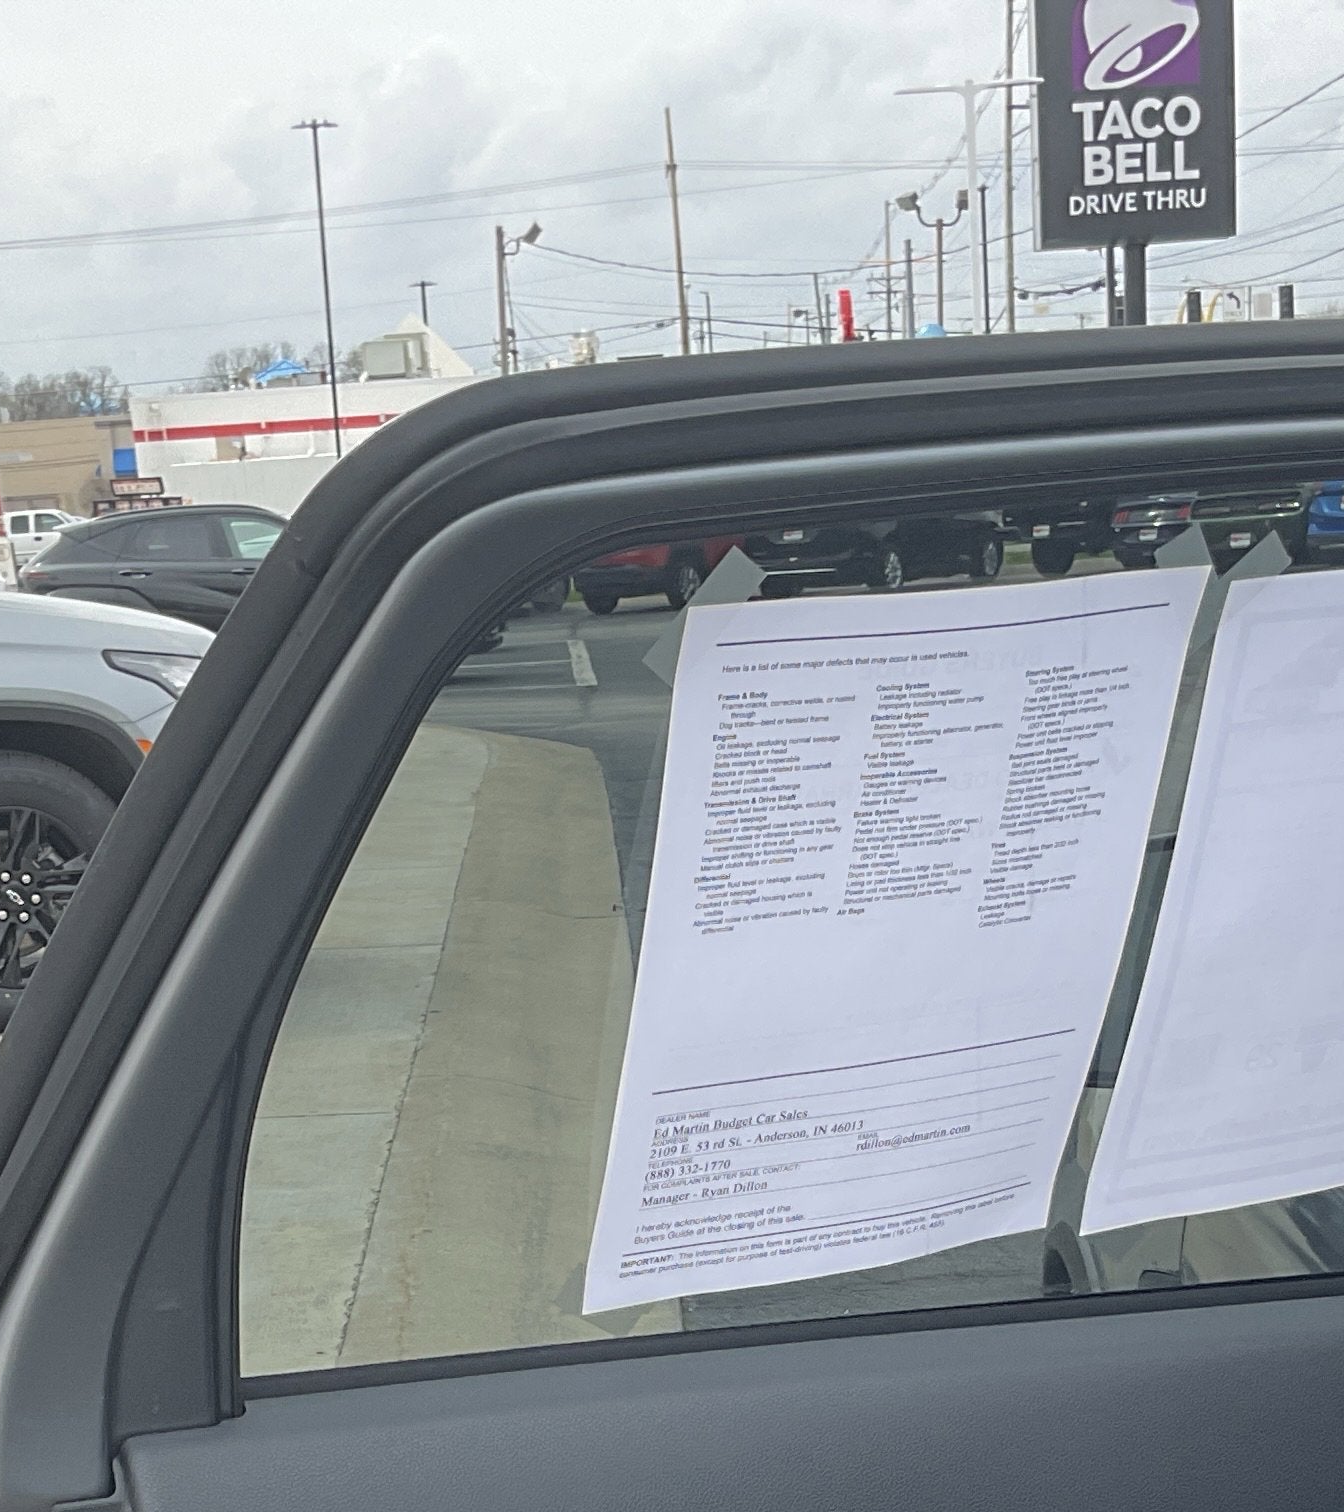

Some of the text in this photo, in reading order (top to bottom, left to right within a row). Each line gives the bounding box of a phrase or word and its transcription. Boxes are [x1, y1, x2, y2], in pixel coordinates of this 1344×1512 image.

[1072, 96, 1200, 141] TACO
[1083, 141, 1199, 186] BELL
[1069, 187, 1207, 216] DRIVE THRU
[721, 664, 741, 673] Here
[757, 662, 769, 670] list
[802, 658, 824, 669] major
[825, 656, 853, 666] defects
[854, 655, 870, 664] that
[870, 656, 887, 664] may
[910, 652, 918, 660] in
[918, 650, 937, 659] used
[938, 649, 969, 658] vehicles.
[652, 1109, 808, 1139] Ed Martin Budget Car Sales
[649, 1146, 676, 1159] 2109
[695, 1141, 709, 1153] 53
[712, 1139, 724, 1150] rd
[753, 1131, 809, 1145] Anderson,
[812, 1125, 827, 1136] IN
[830, 1120, 863, 1134] 46013
[644, 1159, 730, 1184] (888) 332-1770
[641, 1193, 689, 1208] Manager
[700, 1188, 729, 1200] Ryan
[732, 1181, 768, 1194] Dillon
[633, 1234, 665, 1245] Buyers
[666, 1229, 694, 1240] Guide
[696, 1227, 705, 1235] at
[706, 1225, 721, 1234] the
[723, 1221, 754, 1231] closing
[756, 1218, 765, 1226] of
[635, 1204, 791, 1233] I hereby acknowledge receipt of the
